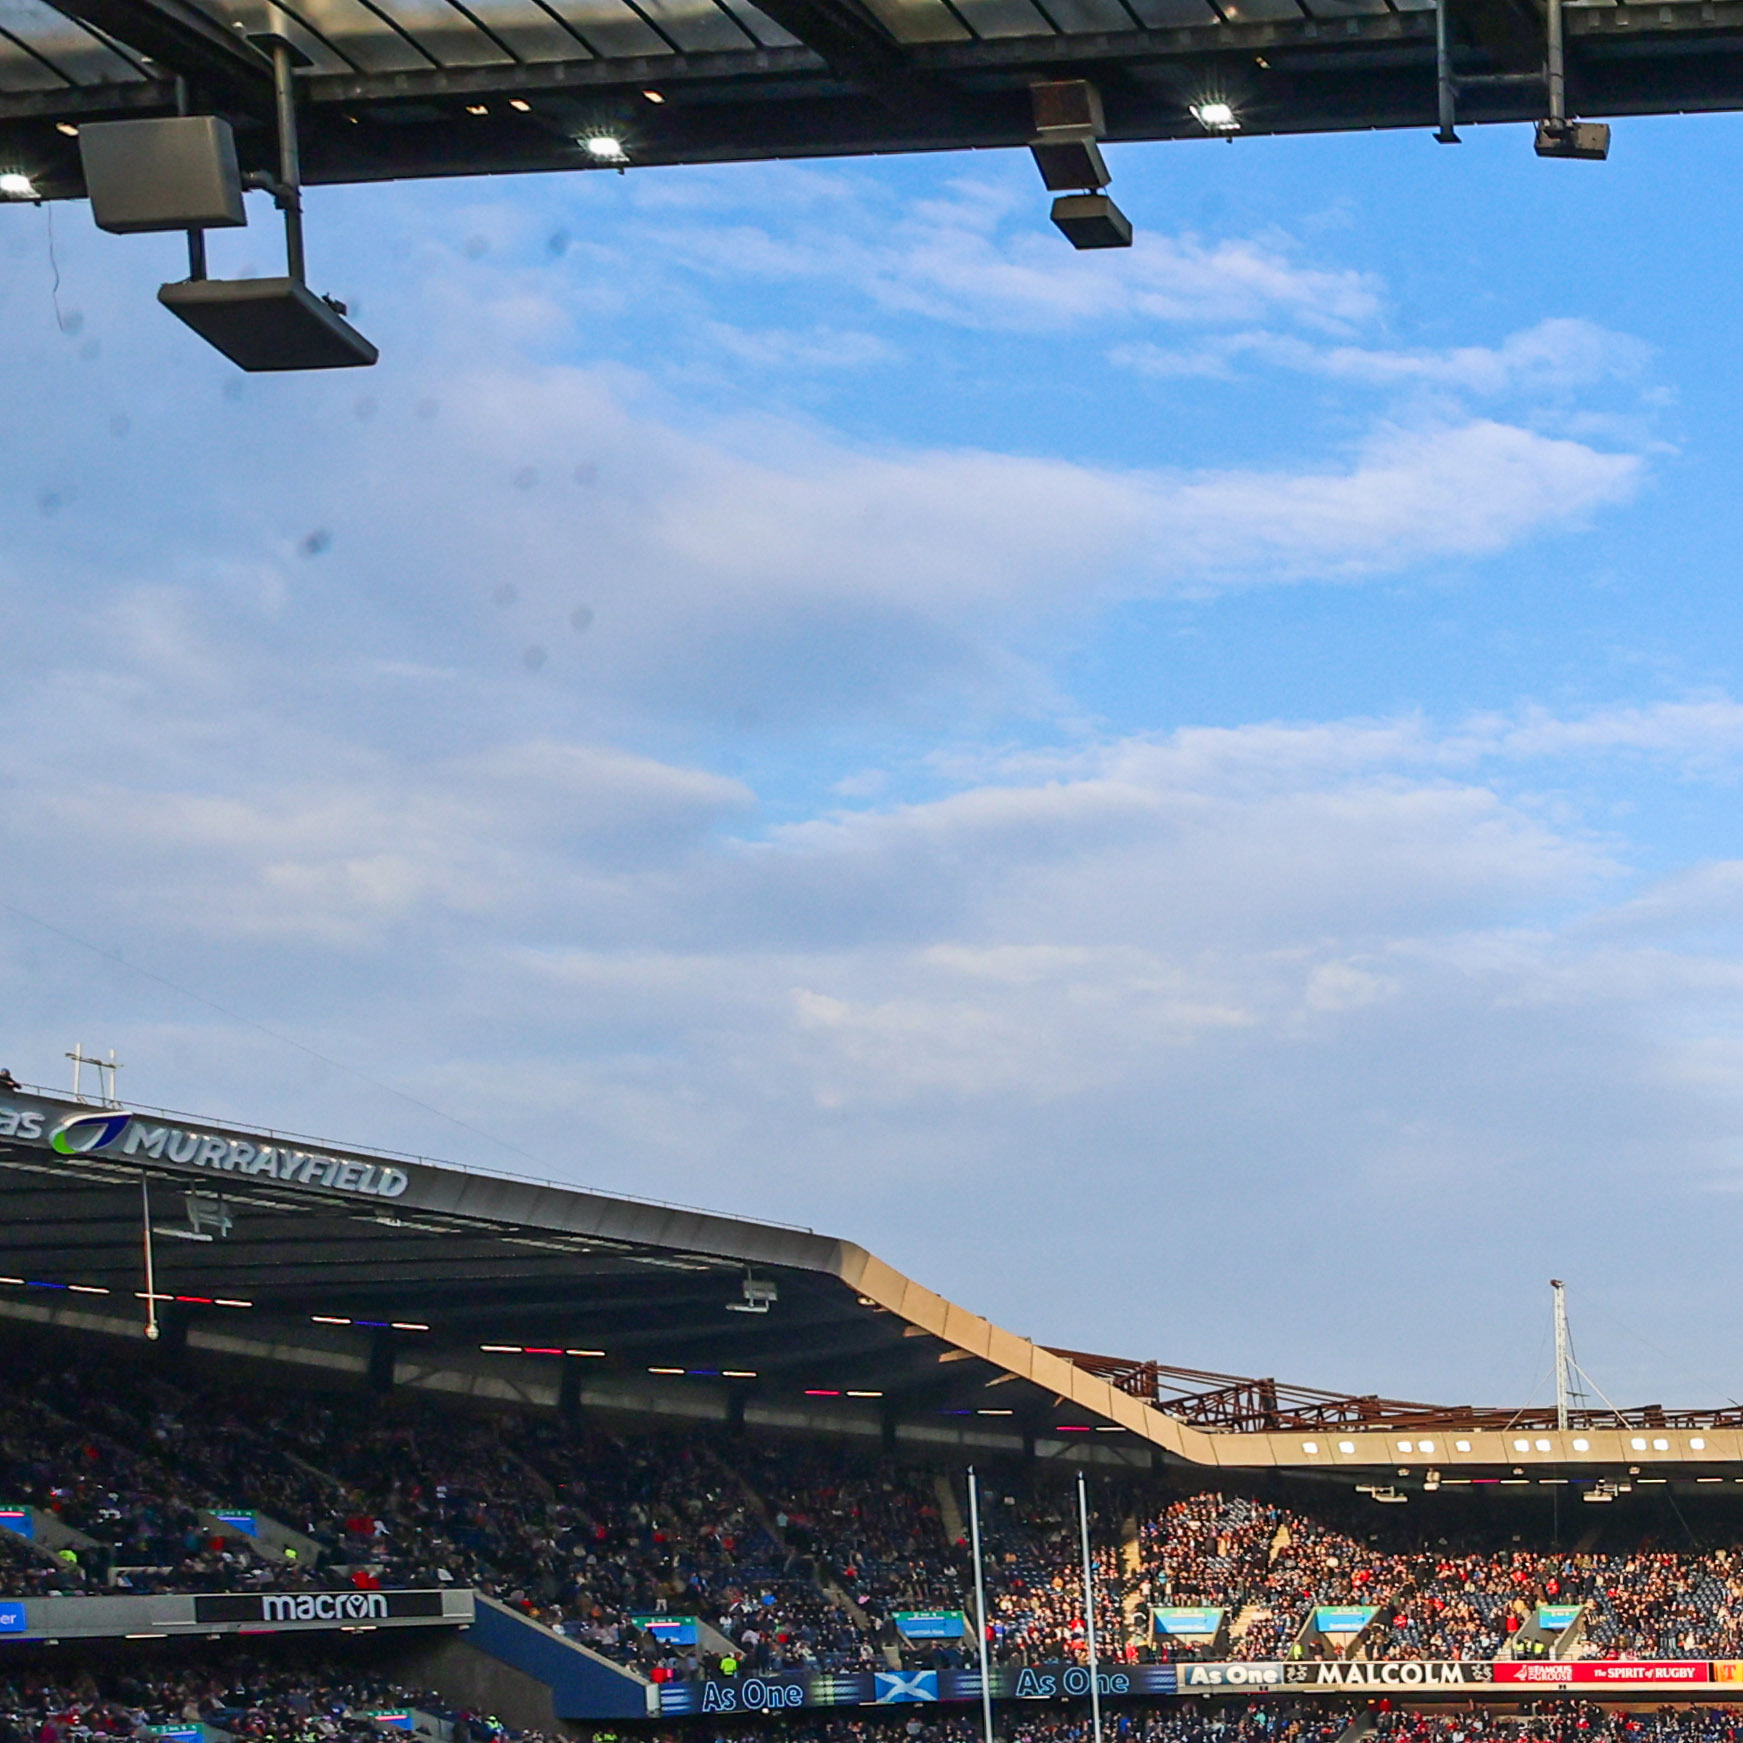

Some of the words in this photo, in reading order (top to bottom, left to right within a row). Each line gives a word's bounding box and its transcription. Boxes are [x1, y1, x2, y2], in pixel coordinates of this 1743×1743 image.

[123, 1122, 409, 1198] MURRAYFIELD
[262, 1594, 388, 1622] macron
[1016, 1669, 1055, 1696] As
[1062, 1667, 1130, 1695] One
[1190, 1665, 1221, 1684] As
[1226, 1665, 1278, 1684] One
[1316, 1663, 1465, 1684] MALCOLM
[1607, 1668, 1645, 1679] SPIRIT
[1655, 1668, 1696, 1679] RUGBY
[702, 1681, 736, 1713] As
[741, 1678, 804, 1710] One
